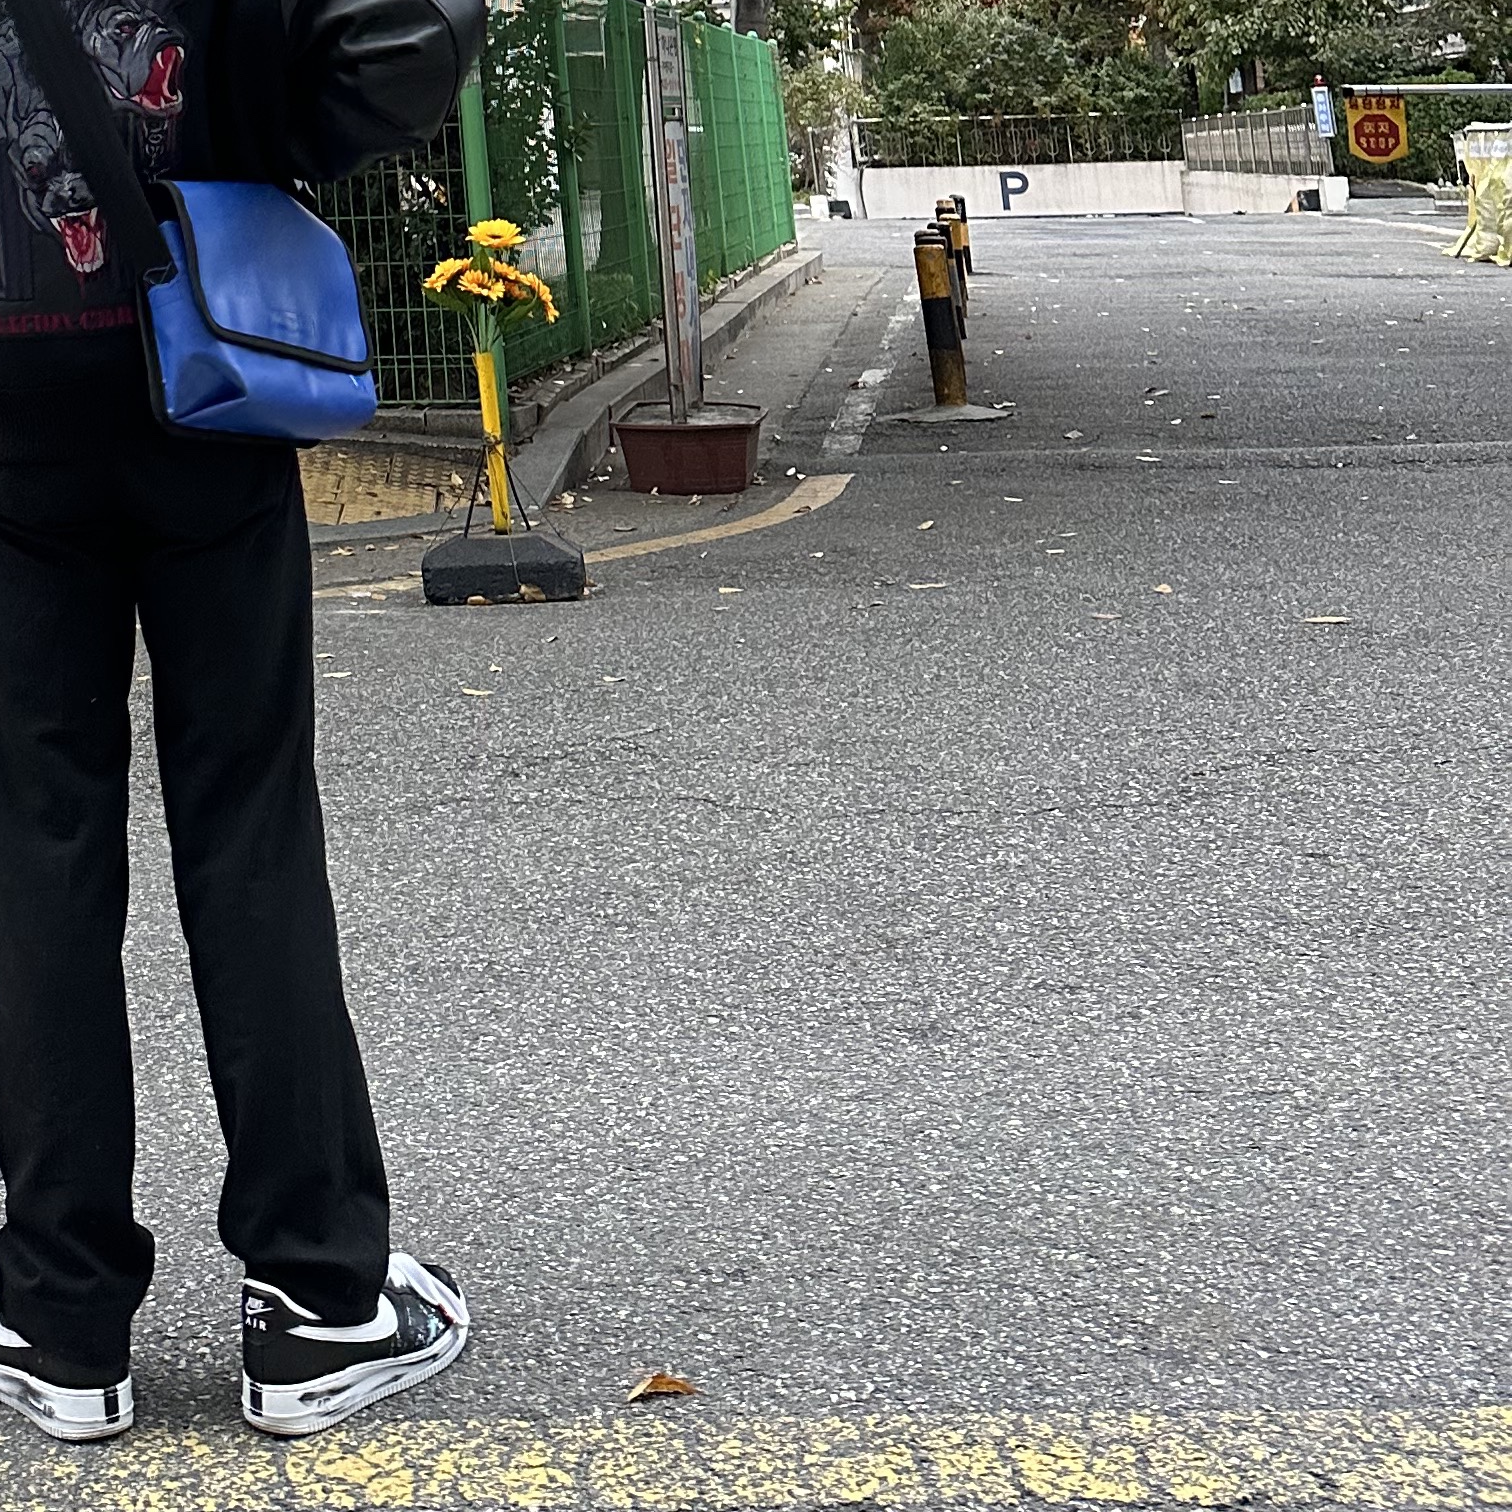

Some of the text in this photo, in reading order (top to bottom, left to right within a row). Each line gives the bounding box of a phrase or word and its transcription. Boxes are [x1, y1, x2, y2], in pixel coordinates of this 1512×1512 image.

[1359, 137, 1396, 149] STOP
[999, 171, 1029, 211] P
[245, 1316, 267, 1331] AIR
